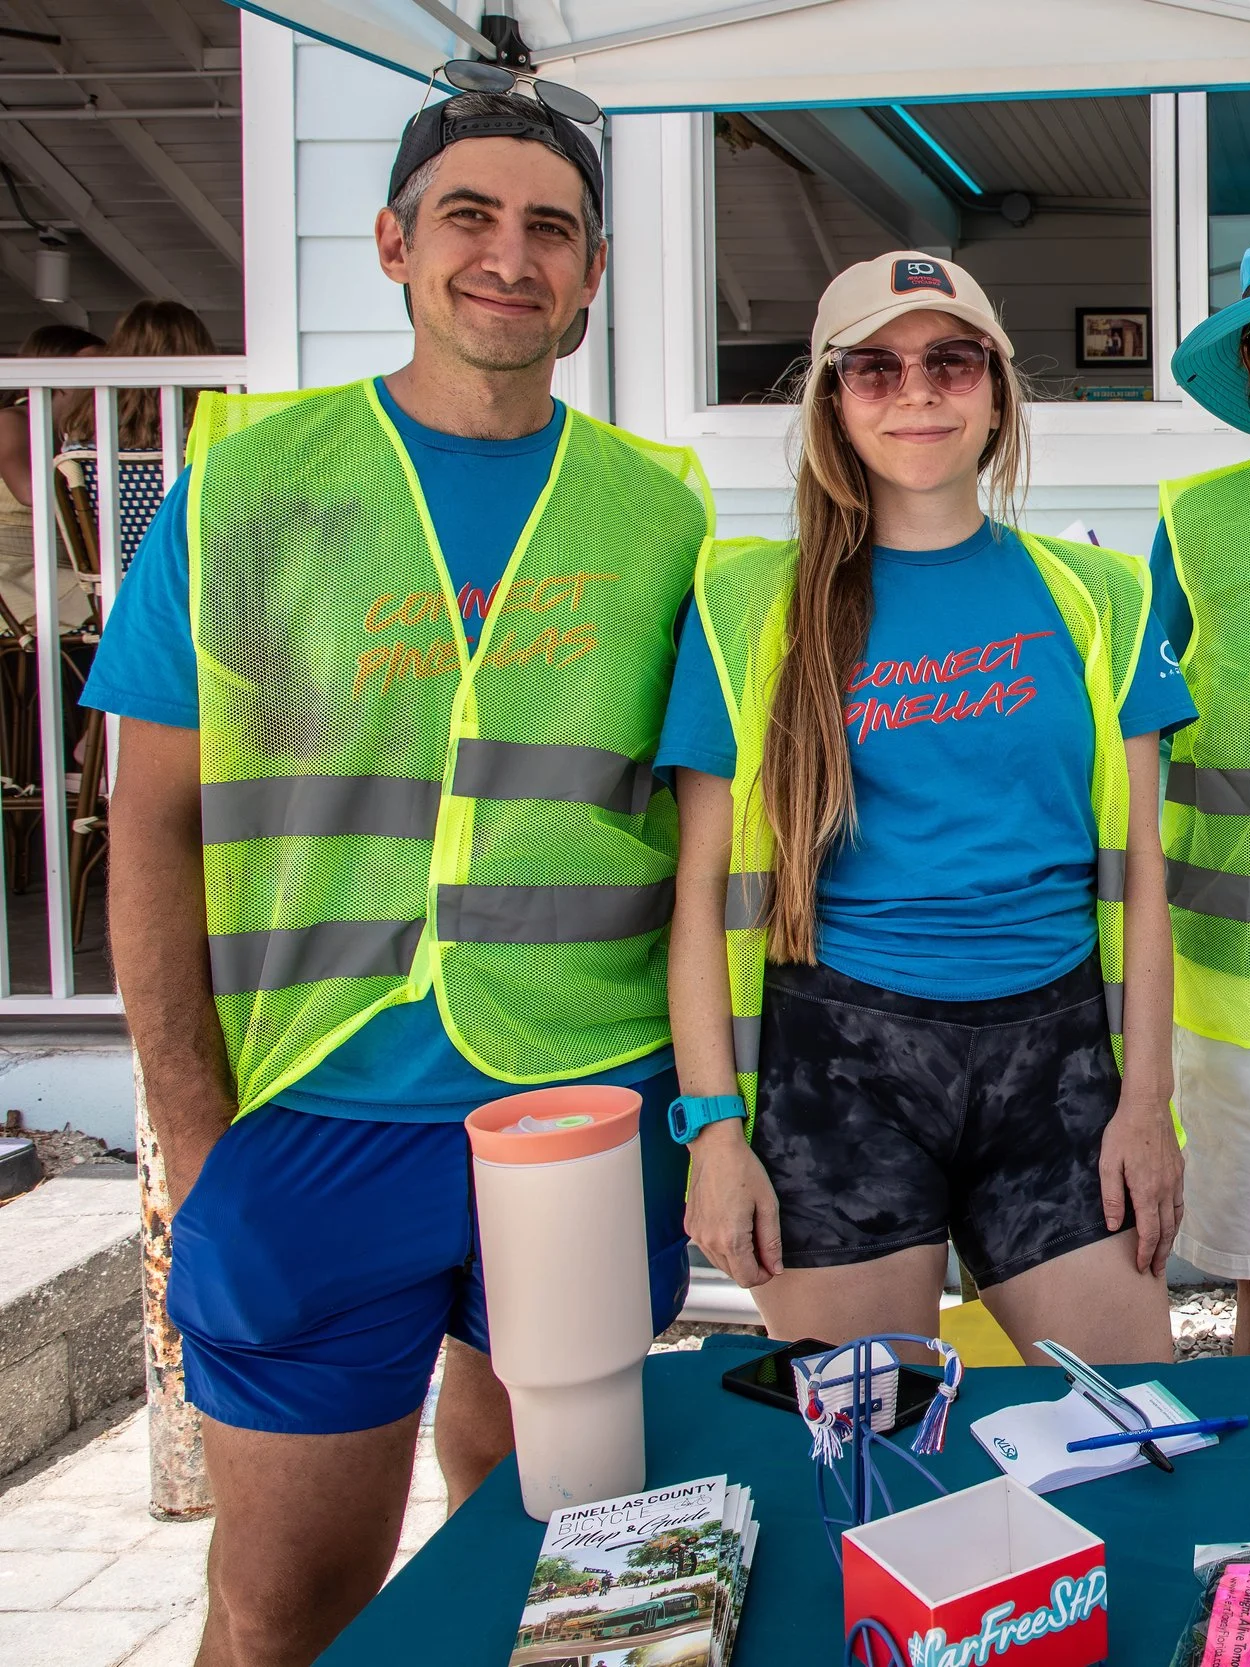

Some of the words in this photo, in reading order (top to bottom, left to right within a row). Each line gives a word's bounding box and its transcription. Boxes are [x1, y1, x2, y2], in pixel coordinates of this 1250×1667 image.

[907, 262, 934, 275] 50
[365, 569, 622, 634] CONNECT
[352, 624, 598, 702] PINELAS
[845, 630, 1056, 693] CONNECT
[844, 676, 1038, 745] PINELLAS
[552, 1530, 621, 1550] Map
[626, 1525, 636, 1533] &
[637, 1507, 711, 1536] Guide
[558, 1508, 653, 1536] BICYCLE
[560, 1499, 644, 1523] PINELLAS
[647, 1483, 717, 1504] COUNTY
[909, 1570, 1107, 1667] #CarFreeStP
[1235, 1618, 1250, 1642] Alive
